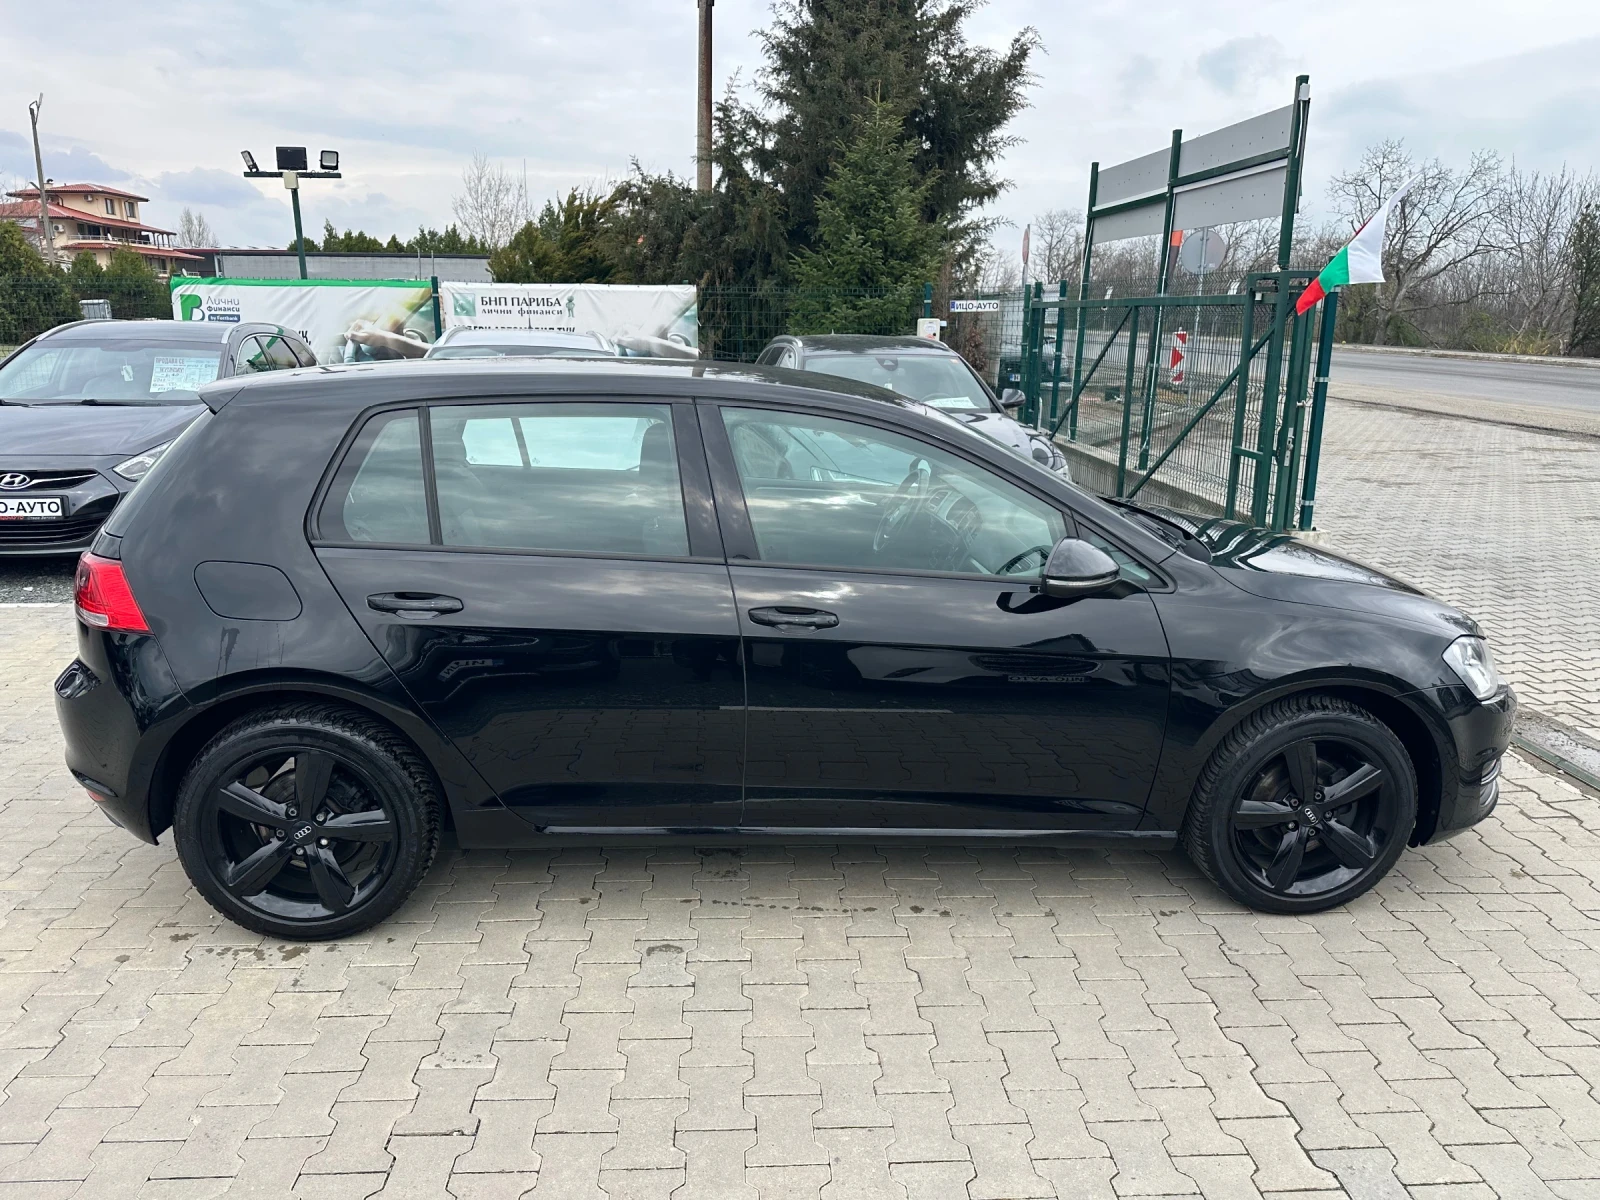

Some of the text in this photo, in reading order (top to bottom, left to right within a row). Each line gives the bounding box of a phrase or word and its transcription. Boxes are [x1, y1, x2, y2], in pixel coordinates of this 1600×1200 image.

[206, 296, 240, 306] Лични
[481, 297, 562, 307] БНП ПАРИБА
[956, 302, 999, 310] ИЦО-АУТО
[518, 307, 563, 317] финанси
